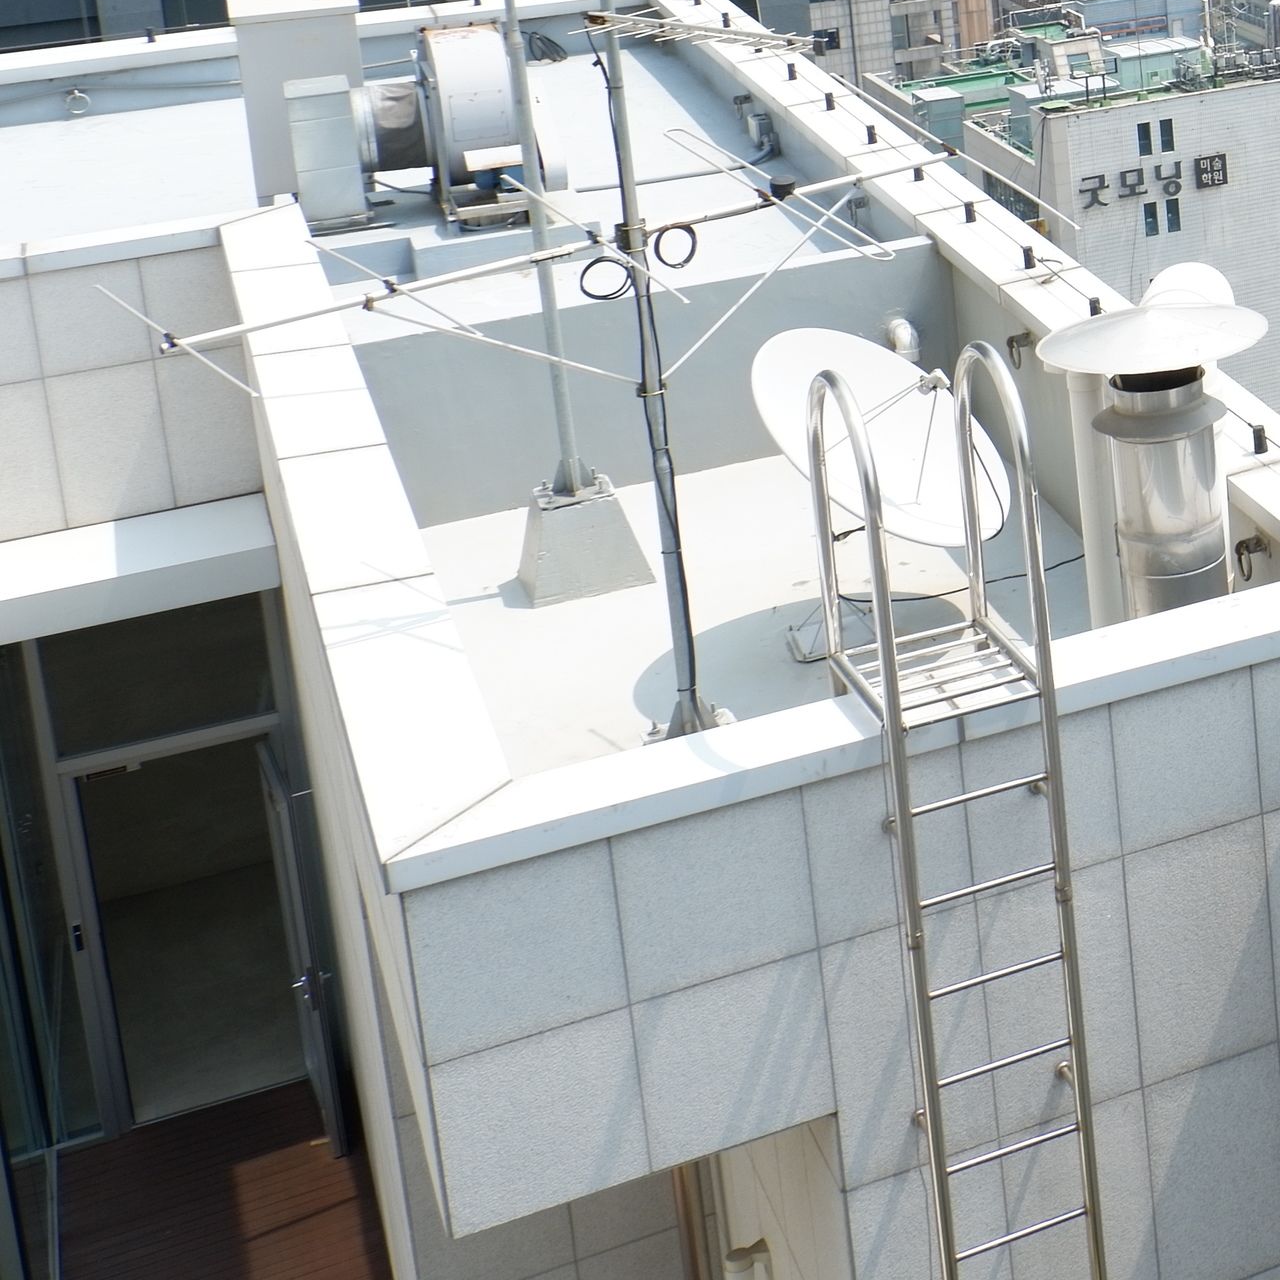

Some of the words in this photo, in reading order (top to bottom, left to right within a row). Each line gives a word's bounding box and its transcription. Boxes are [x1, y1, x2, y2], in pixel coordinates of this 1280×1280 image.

[1200, 157, 1222, 171] 미술
[1079, 160, 1182, 209] 굿모닝
[1201, 170, 1223, 186] 학원
